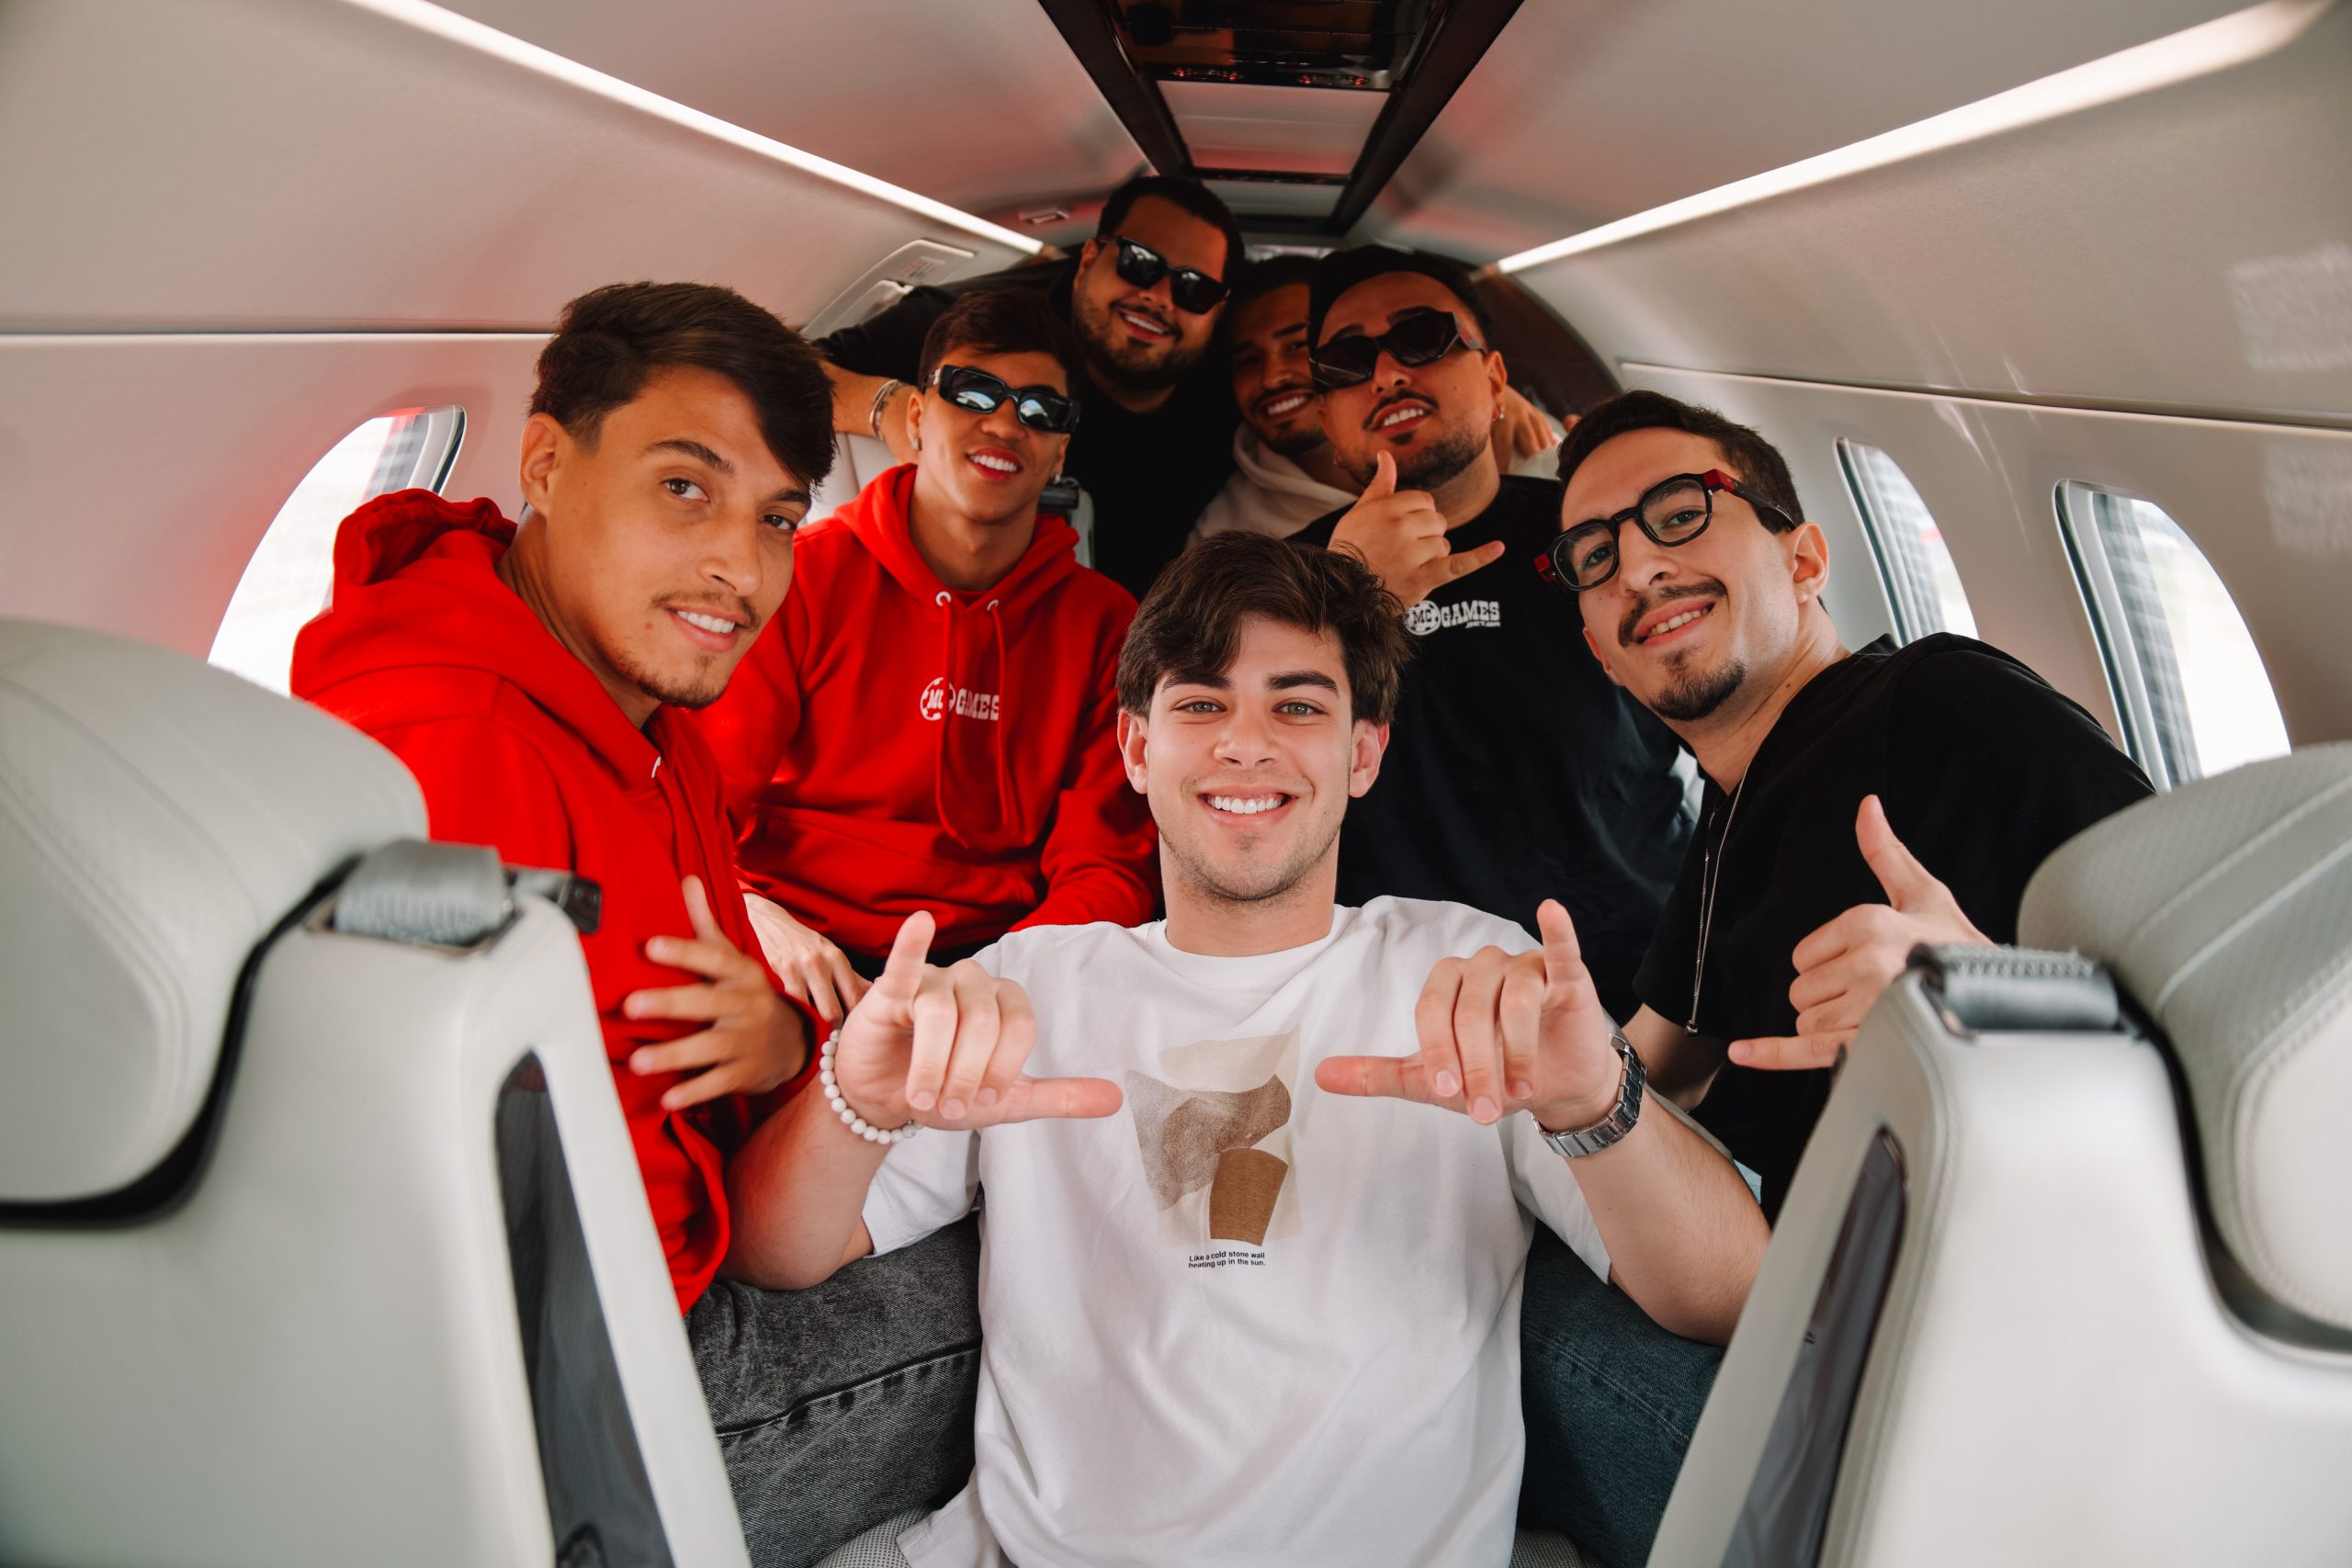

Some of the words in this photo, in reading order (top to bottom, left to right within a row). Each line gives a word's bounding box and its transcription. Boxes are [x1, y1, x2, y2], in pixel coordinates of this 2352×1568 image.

[1413, 608, 1432, 625] MC
[1441, 600, 1500, 628] GAMES
[956, 687, 1000, 721] GAMES
[1211, 1251, 1227, 1259] cold
